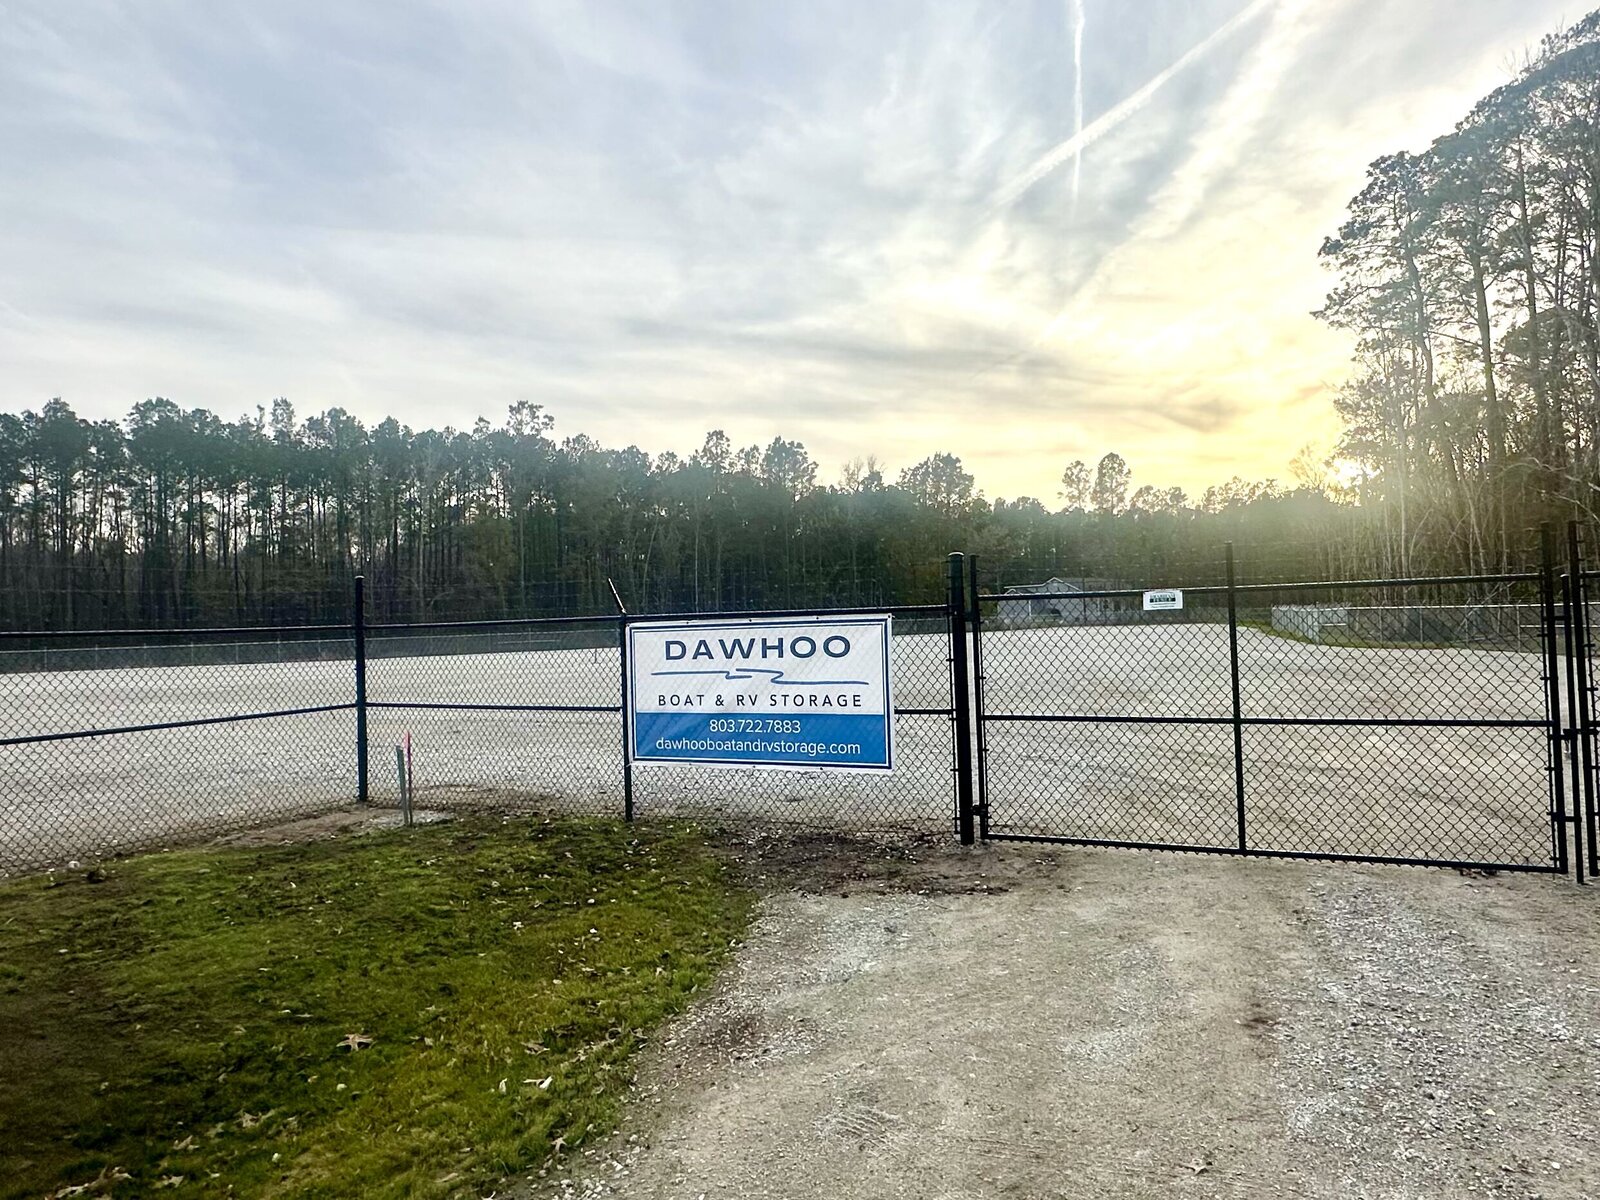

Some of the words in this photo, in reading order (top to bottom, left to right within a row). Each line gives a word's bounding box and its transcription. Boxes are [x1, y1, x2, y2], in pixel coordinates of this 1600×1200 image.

[665, 635, 851, 661] DAWHOO
[658, 694, 705, 707] BOAT
[715, 694, 724, 706] &
[736, 694, 758, 706] RV
[770, 694, 862, 708] STORAGE
[709, 719, 801, 734] 803.722.7883
[655, 737, 861, 757] dawhooboatandrvstorage.com
